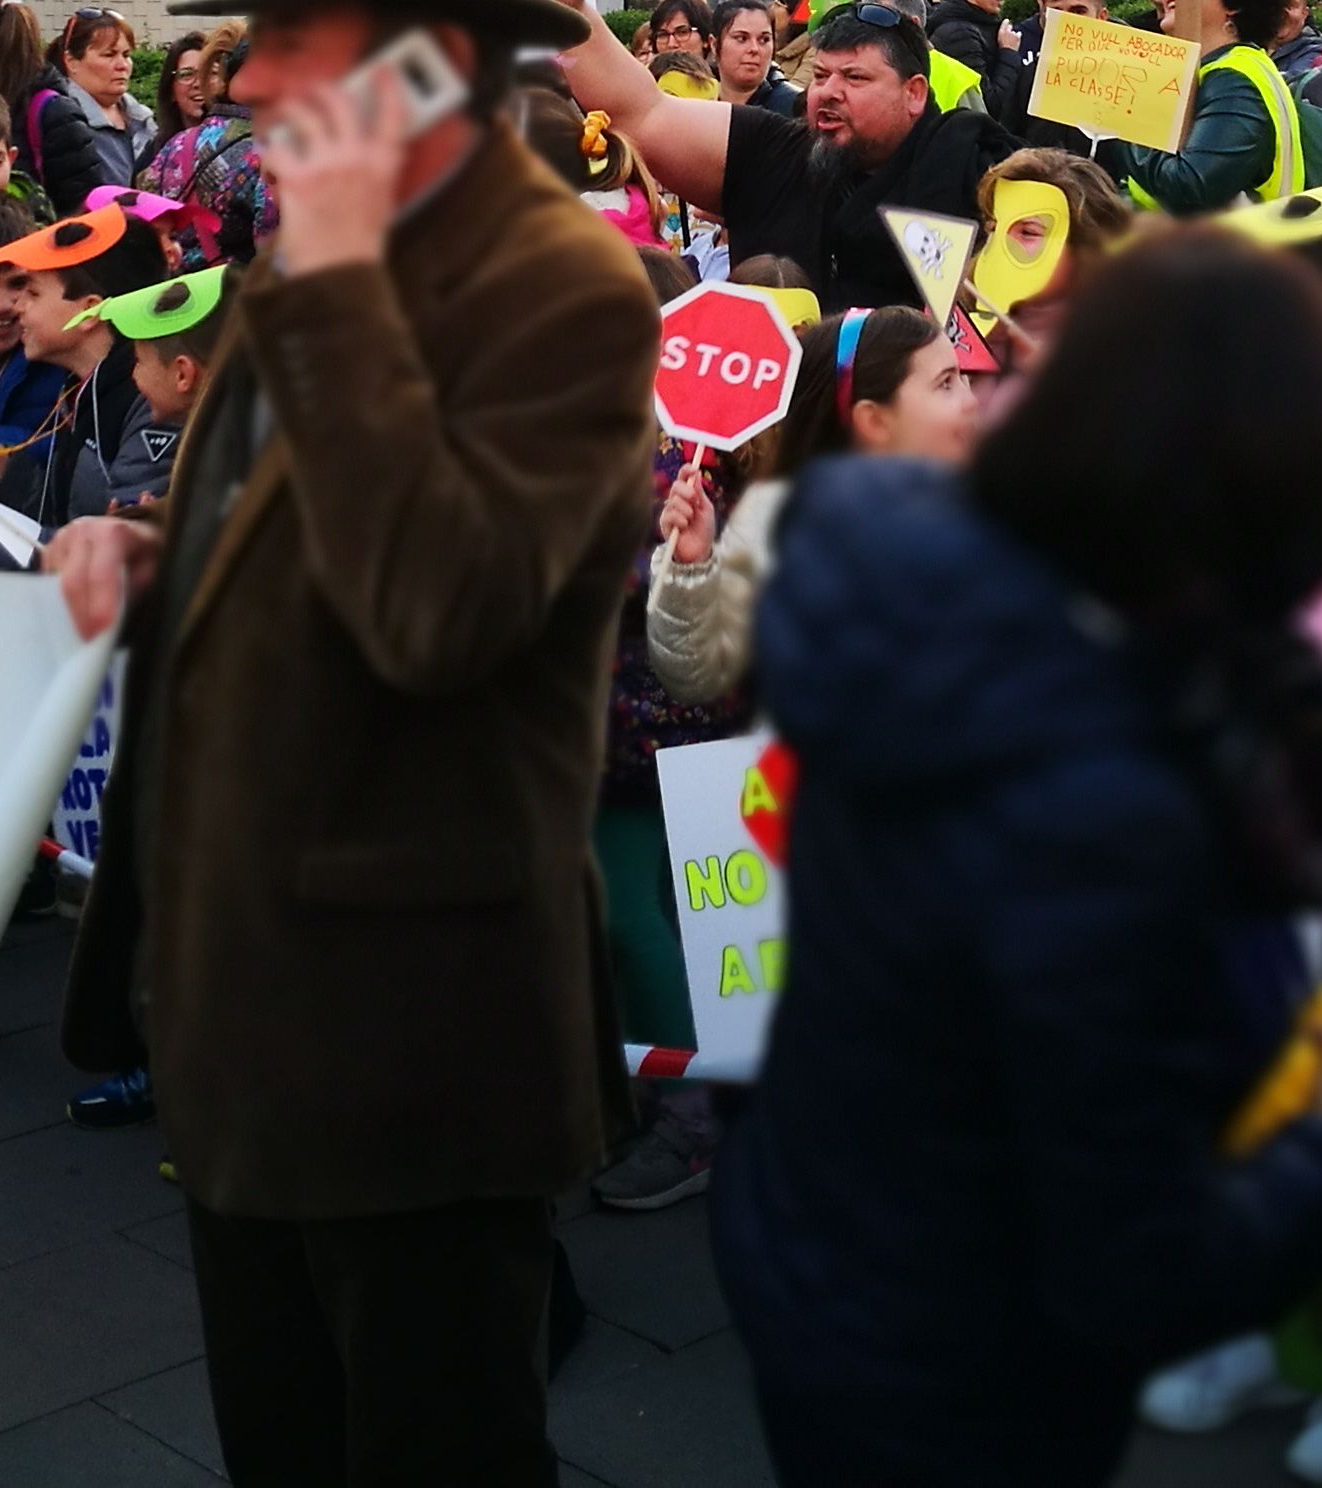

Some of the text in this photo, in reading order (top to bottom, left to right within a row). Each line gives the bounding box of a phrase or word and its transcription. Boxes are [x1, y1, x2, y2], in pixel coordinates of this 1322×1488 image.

[1064, 23, 1187, 60] NO VULL ABOCADOR
[1045, 71, 1061, 86] LA
[1056, 56, 1181, 95] PUDOR A
[660, 334, 782, 390] STOP
[685, 849, 767, 912] NO
